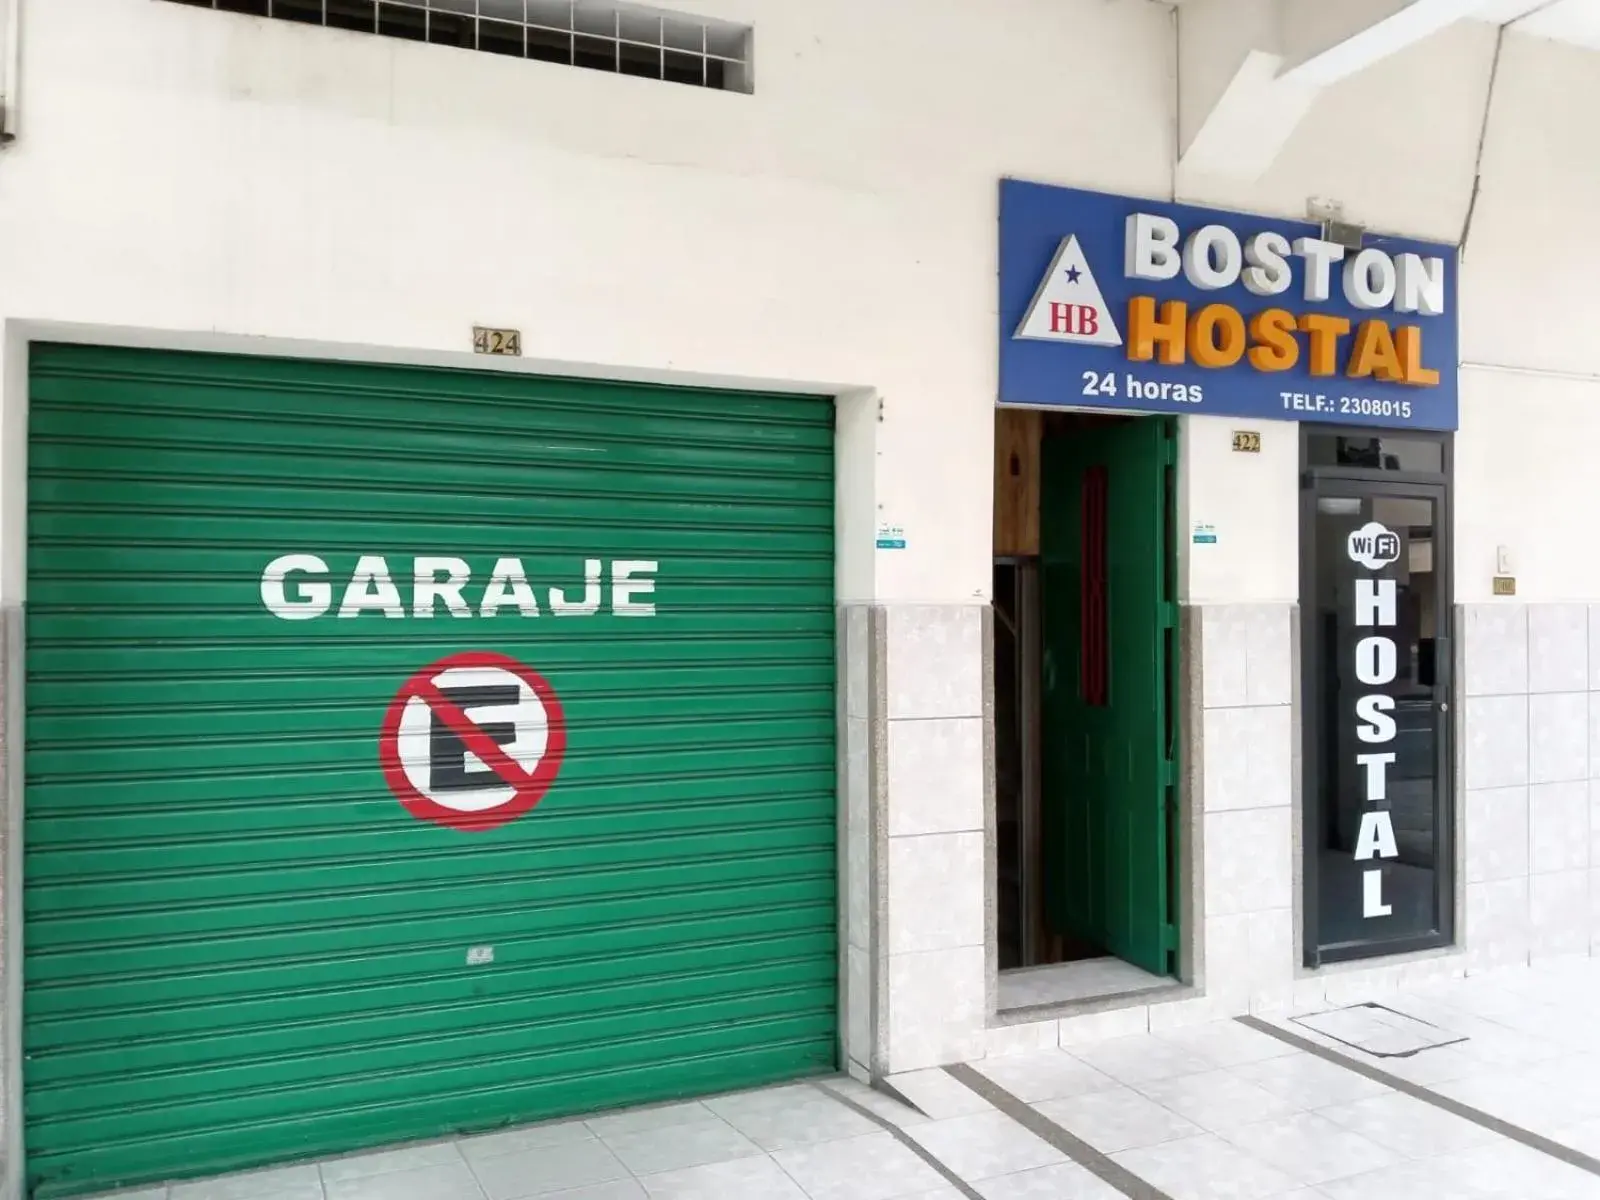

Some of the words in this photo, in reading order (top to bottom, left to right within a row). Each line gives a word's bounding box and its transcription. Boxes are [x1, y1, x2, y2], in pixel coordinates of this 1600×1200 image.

[1125, 213, 1444, 315] BOSTON
[475, 331, 519, 354] 424
[1048, 302, 1099, 335] HB
[1127, 296, 1439, 385] HOSTAL
[1081, 371, 1118, 396] 24
[1127, 375, 1202, 402] horas
[1280, 392, 1335, 412] TELF.:
[1340, 397, 1412, 418] 2308015
[260, 554, 658, 620] GARAJE
[1354, 579, 1399, 918] HOSTAL
